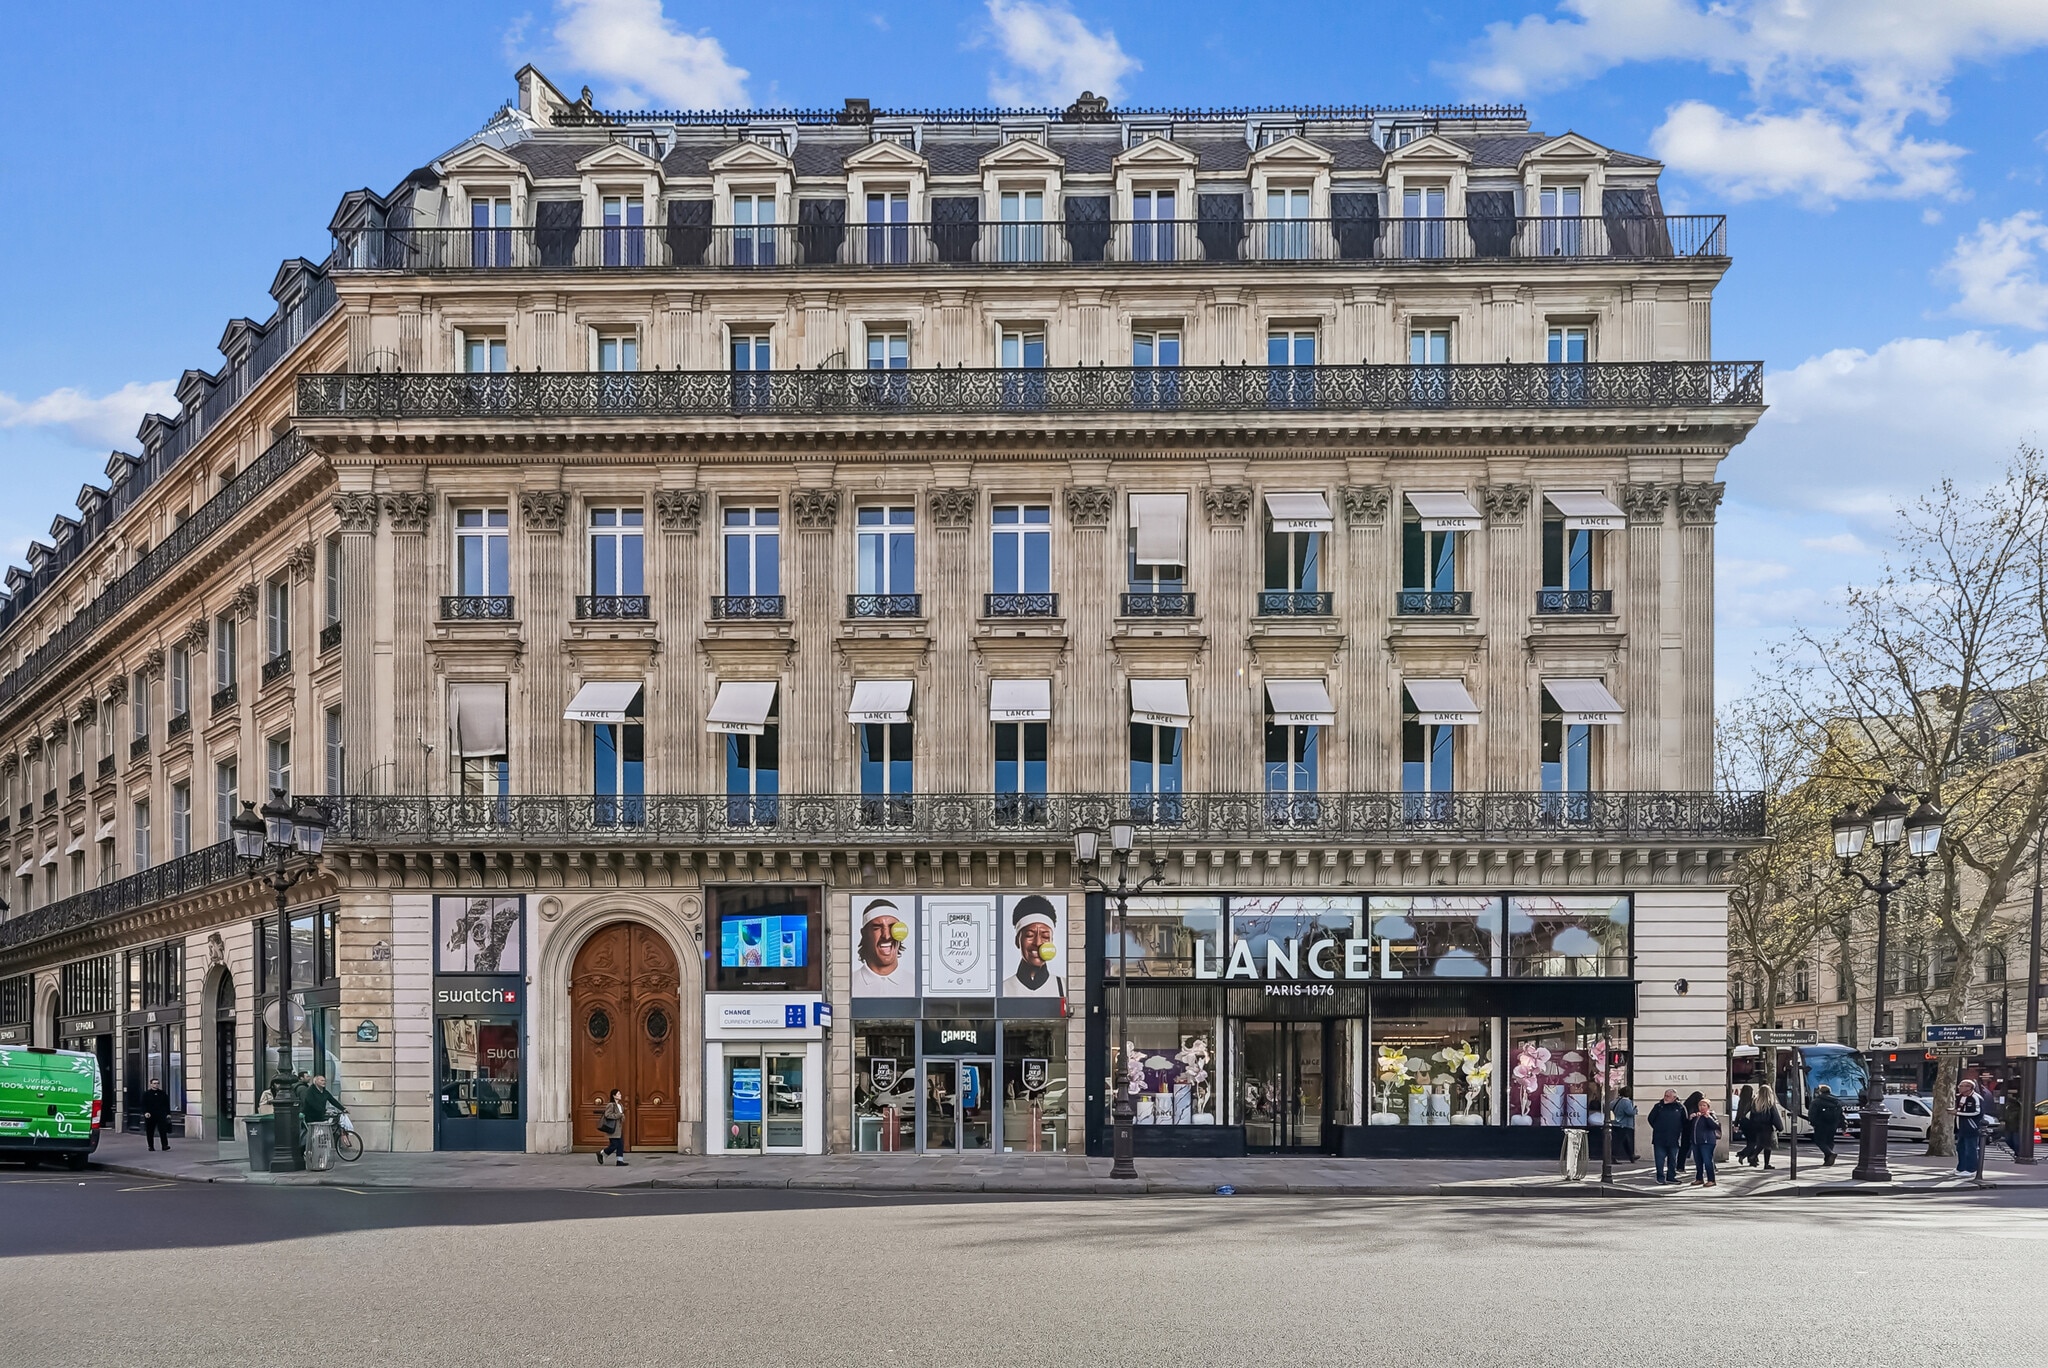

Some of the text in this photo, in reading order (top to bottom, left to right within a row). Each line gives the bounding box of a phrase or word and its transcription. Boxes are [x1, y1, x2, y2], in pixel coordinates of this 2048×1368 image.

[1146, 714, 1173, 723] LANCEL
[721, 722, 748, 730] LANCEL
[949, 914, 970, 922] CAMPER
[952, 929, 968, 938] Loco
[1195, 939, 1403, 980] LANCEL
[438, 988, 503, 1003] swatch
[1265, 985, 1334, 996] PARIS 1876
[76, 1020, 94, 1031] SEPHORA
[941, 1030, 977, 1044] CAMPER
[24, 1077, 61, 1085] Livraison
